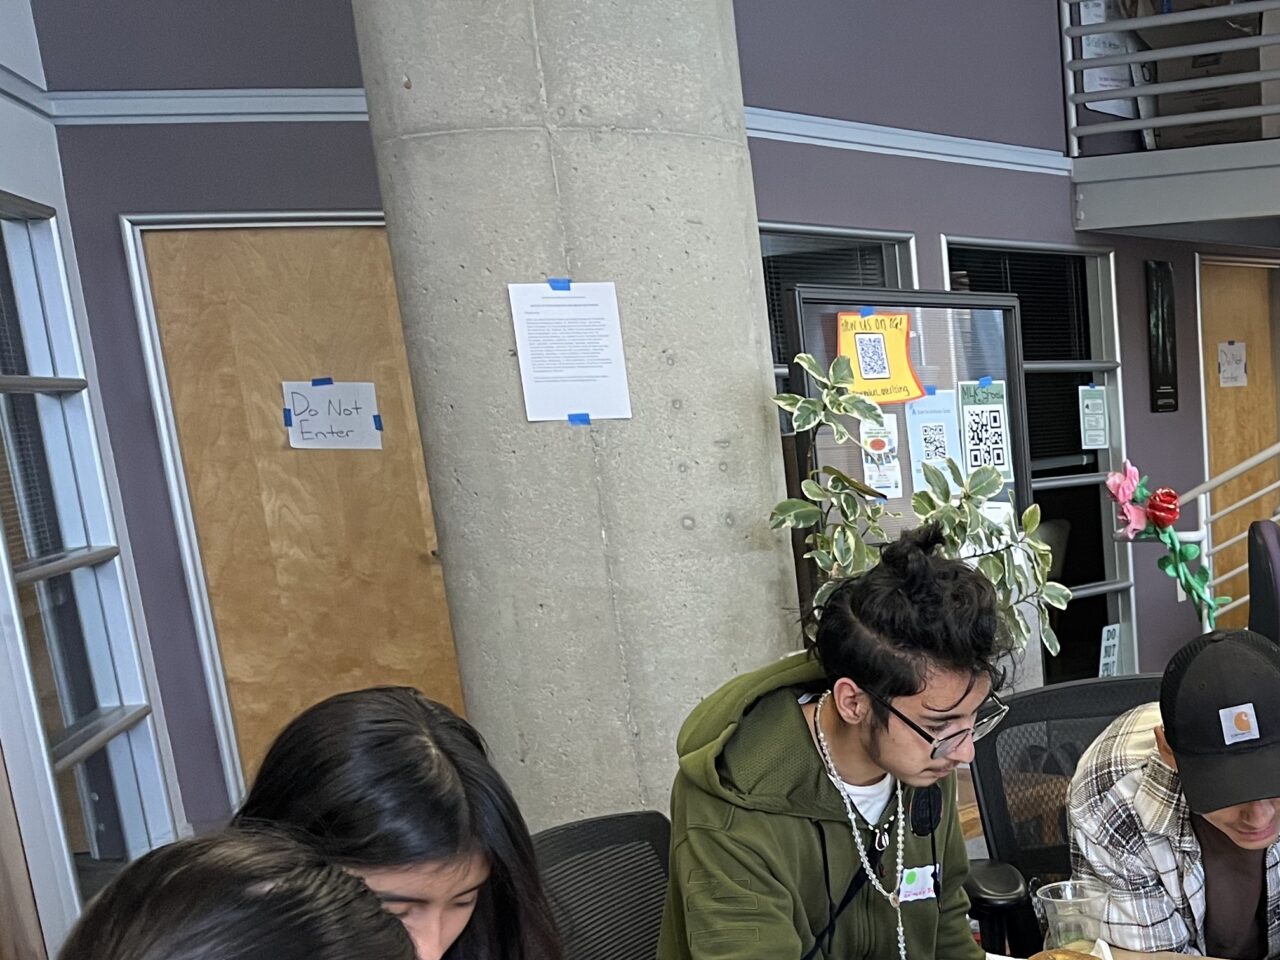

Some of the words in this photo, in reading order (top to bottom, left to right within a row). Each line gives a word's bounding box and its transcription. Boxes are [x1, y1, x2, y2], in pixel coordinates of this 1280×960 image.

[291, 391, 319, 417] Do
[327, 399, 362, 416] Not
[299, 419, 354, 440] Enter
